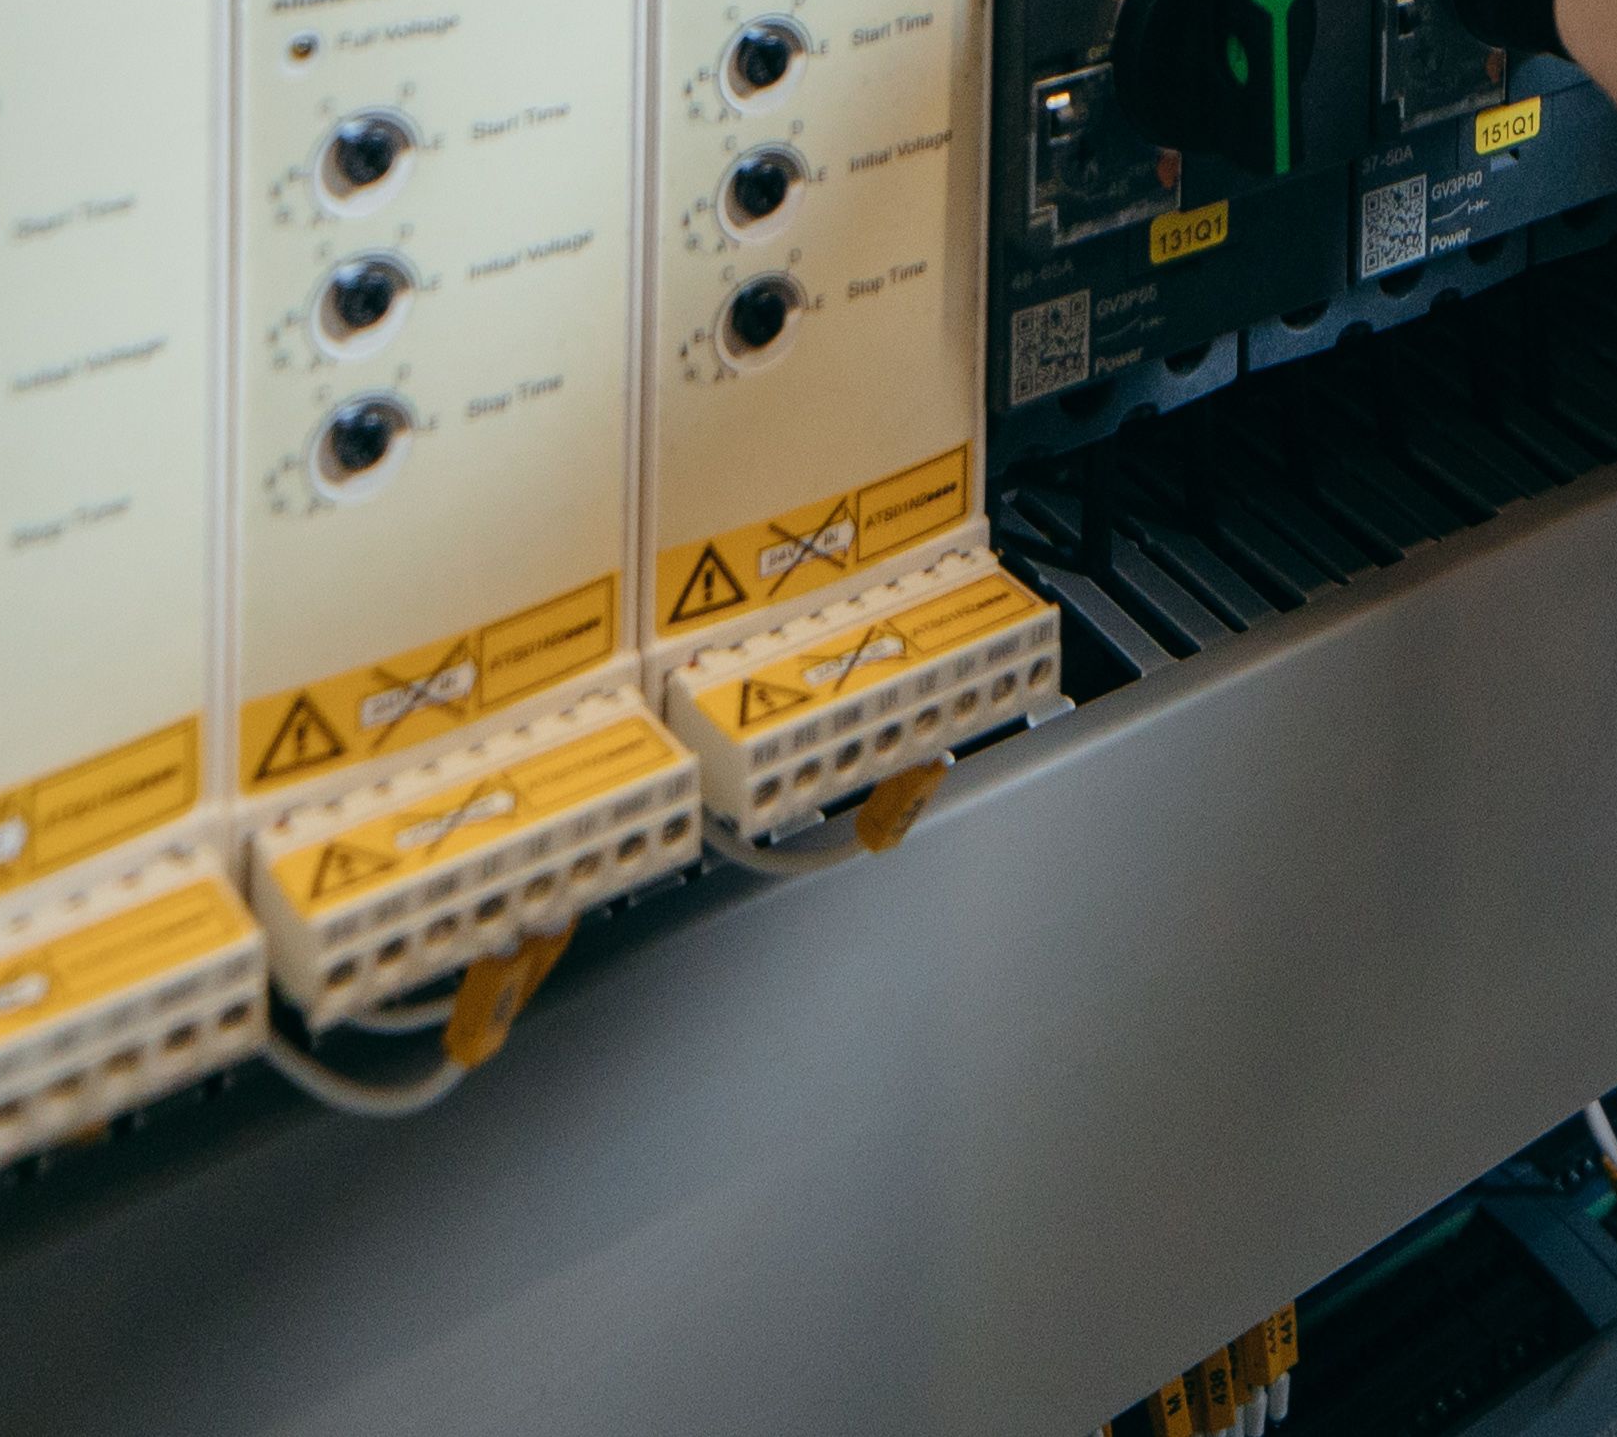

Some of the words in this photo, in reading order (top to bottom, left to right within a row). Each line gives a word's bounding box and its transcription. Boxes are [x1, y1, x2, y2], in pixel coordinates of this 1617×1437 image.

[850, 19, 893, 47] Start
[895, 9, 935, 33] Time
[1482, 111, 1536, 149] 151Q1
[849, 147, 892, 173] Initial
[894, 129, 953, 160] Voltage
[1158, 215, 1223, 255] 131Q1
[1430, 227, 1472, 253] Power
[846, 272, 893, 300] Stop
[894, 257, 928, 286] Time
[1094, 345, 1145, 375] Power
[1210, 1366, 1228, 1409] 438
